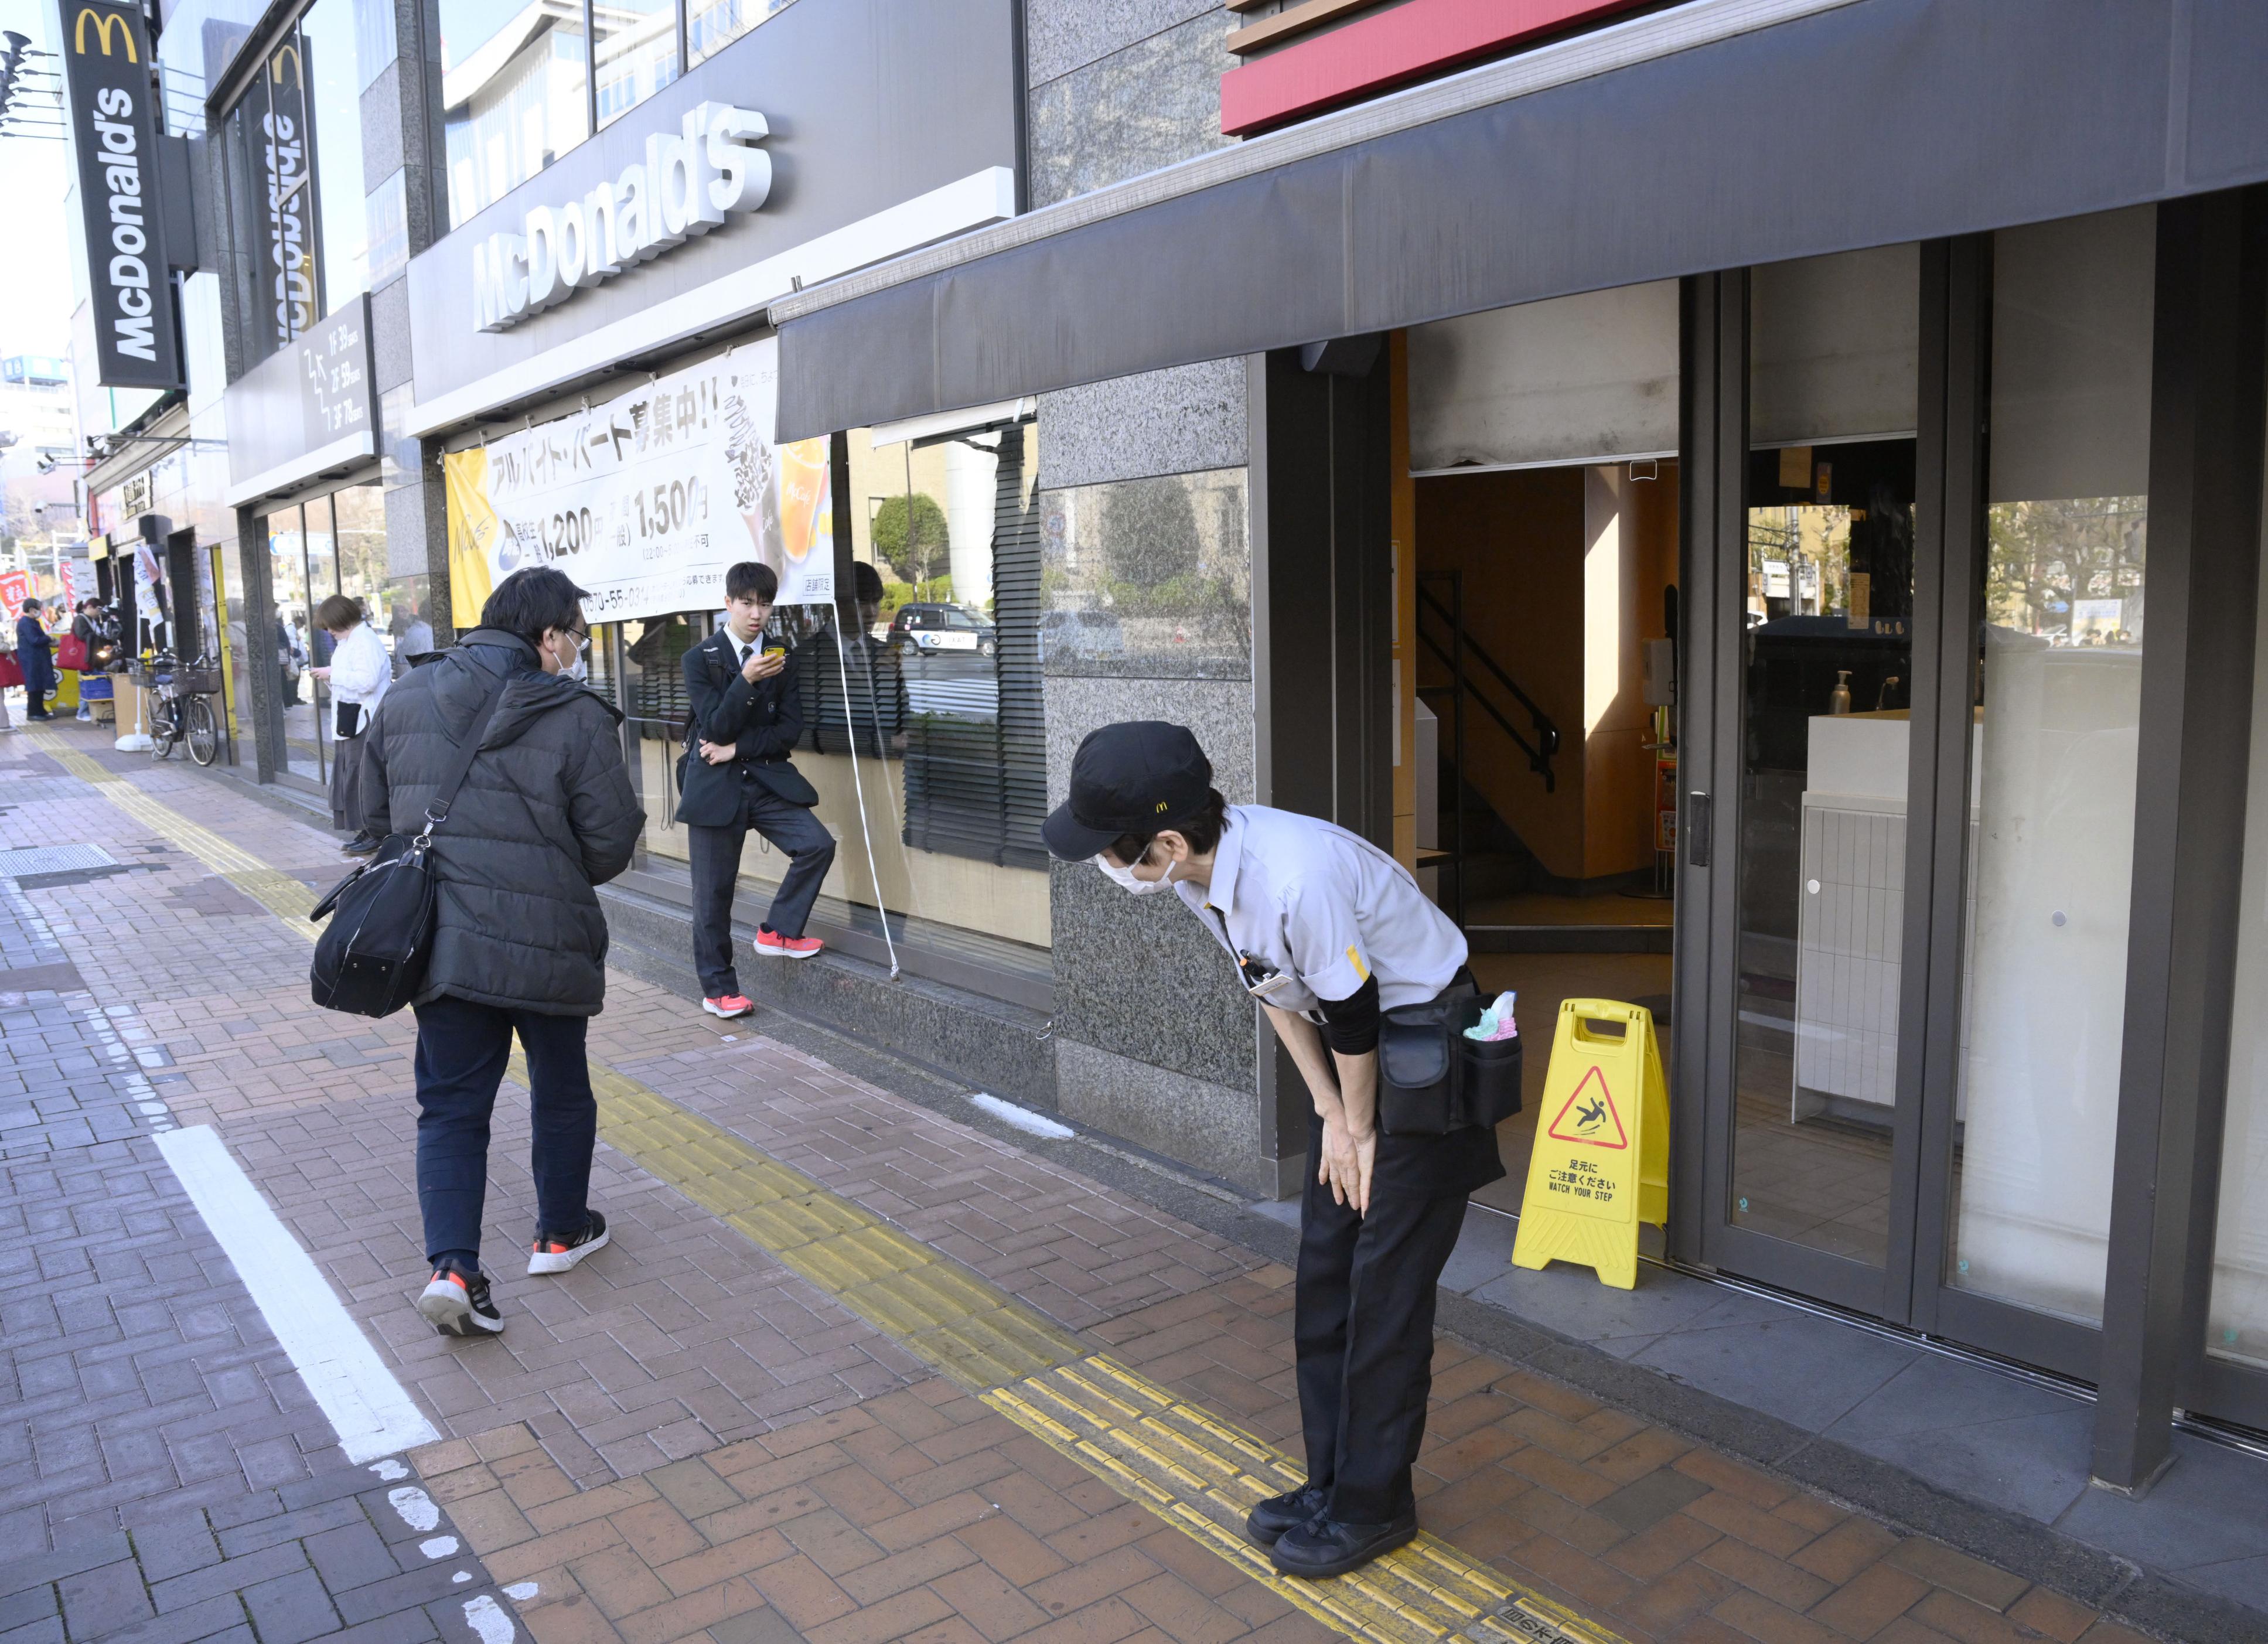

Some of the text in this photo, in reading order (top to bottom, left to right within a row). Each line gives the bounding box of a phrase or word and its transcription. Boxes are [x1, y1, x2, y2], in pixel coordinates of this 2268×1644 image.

[93, 87, 156, 362] McDonald's
[473, 101, 772, 333] McDonald's
[329, 330, 337, 357] 1F
[338, 324, 348, 352] 39
[330, 367, 339, 394] 2F
[341, 360, 351, 388] 59
[333, 403, 342, 430] 3F
[805, 578, 830, 592] 店舗限定
[1549, 1169, 1616, 1190] ご注意ください
[1569, 1159, 1598, 1174] 足元に
[1549, 1181, 1612, 1202] WATCH YOUR STEP
